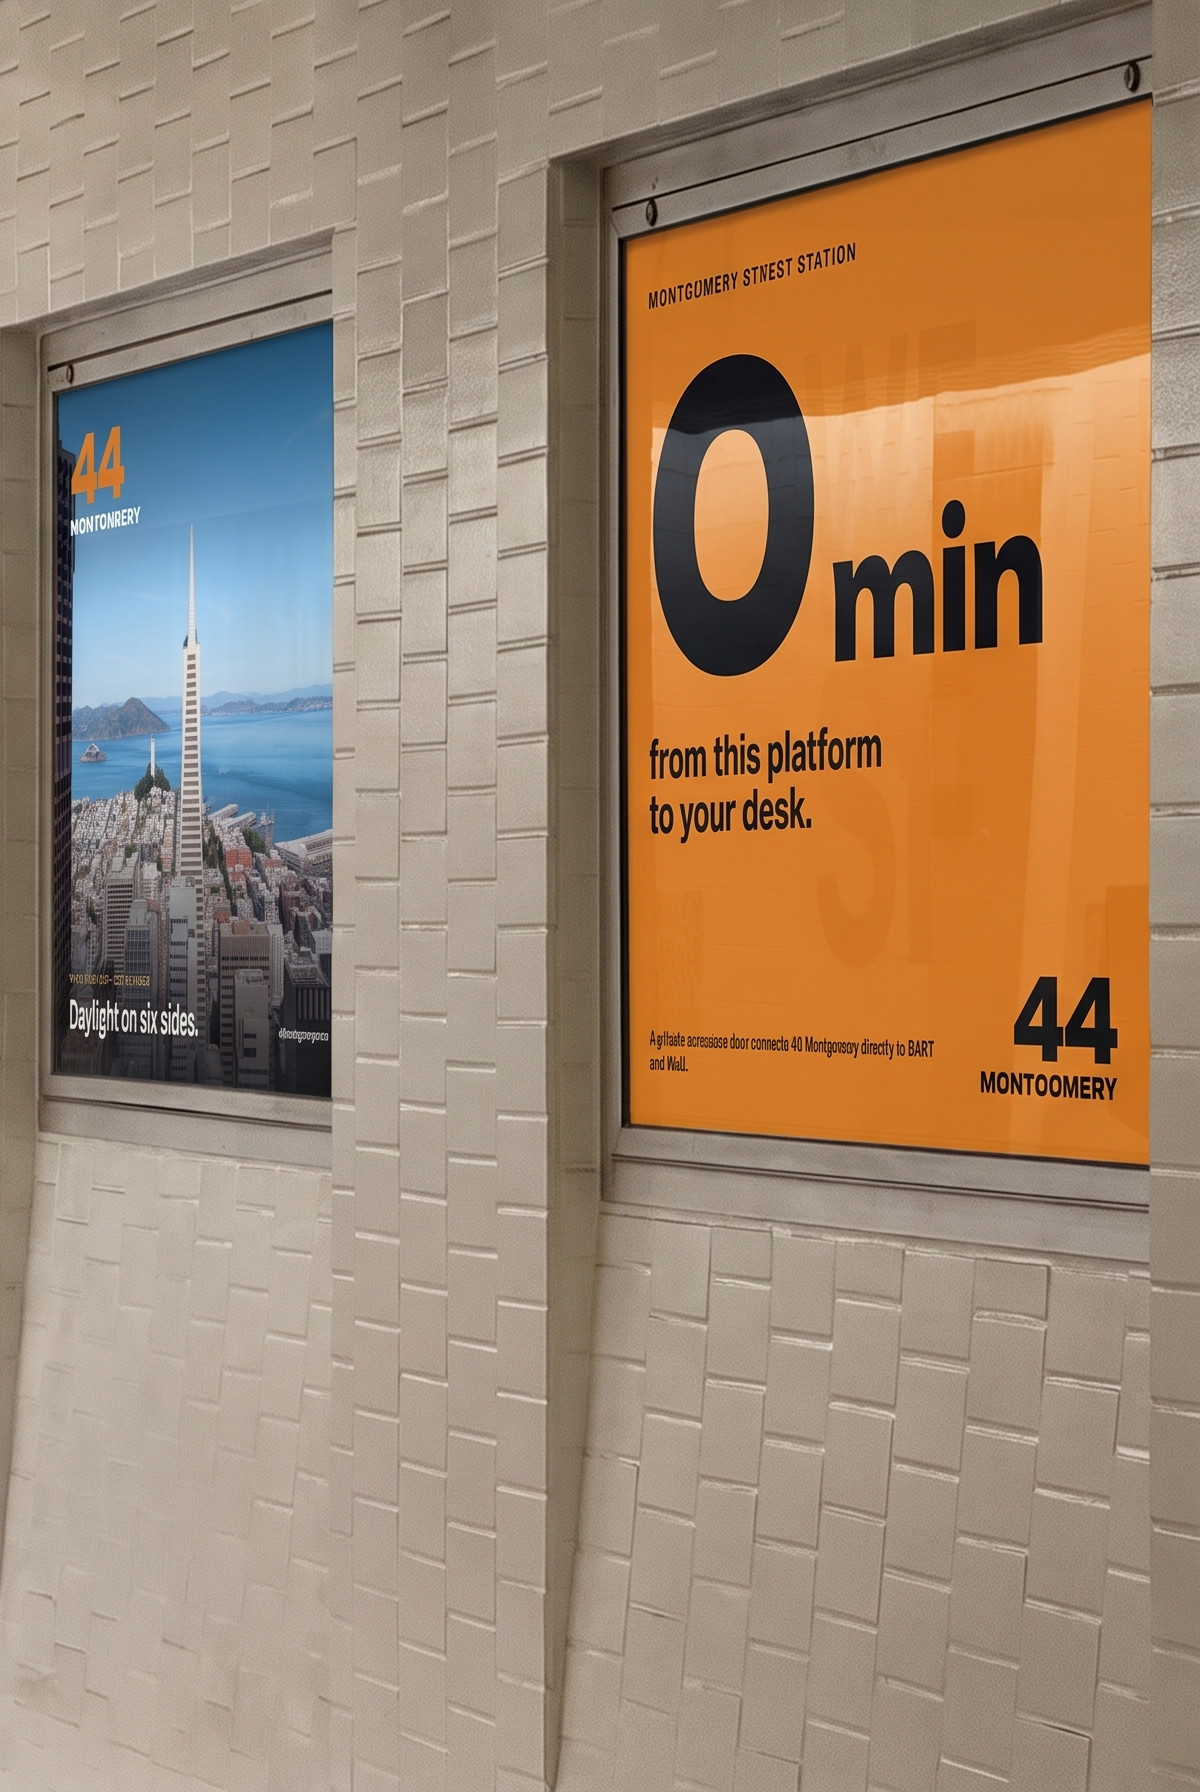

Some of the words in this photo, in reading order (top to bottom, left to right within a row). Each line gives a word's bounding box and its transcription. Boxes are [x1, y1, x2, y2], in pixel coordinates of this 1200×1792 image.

[797, 242, 856, 274] STATION
[70, 425, 125, 505] 44
[832, 499, 1043, 663] min
[649, 738, 707, 780] from
[713, 733, 761, 776] this
[768, 726, 882, 784] platform
[649, 796, 674, 834] to
[679, 800, 736, 844] your
[742, 786, 812, 831] desk.
[69, 998, 120, 1039] Daylight
[121, 1008, 137, 1033] on
[140, 1001, 158, 1035] six
[160, 1002, 199, 1037] sides.
[1013, 976, 1118, 1065] 44
[649, 1055, 665, 1071] and
[729, 1032, 749, 1050] door
[908, 1039, 935, 1058] BART
[980, 1070, 1118, 1101] MONTOOMERY
